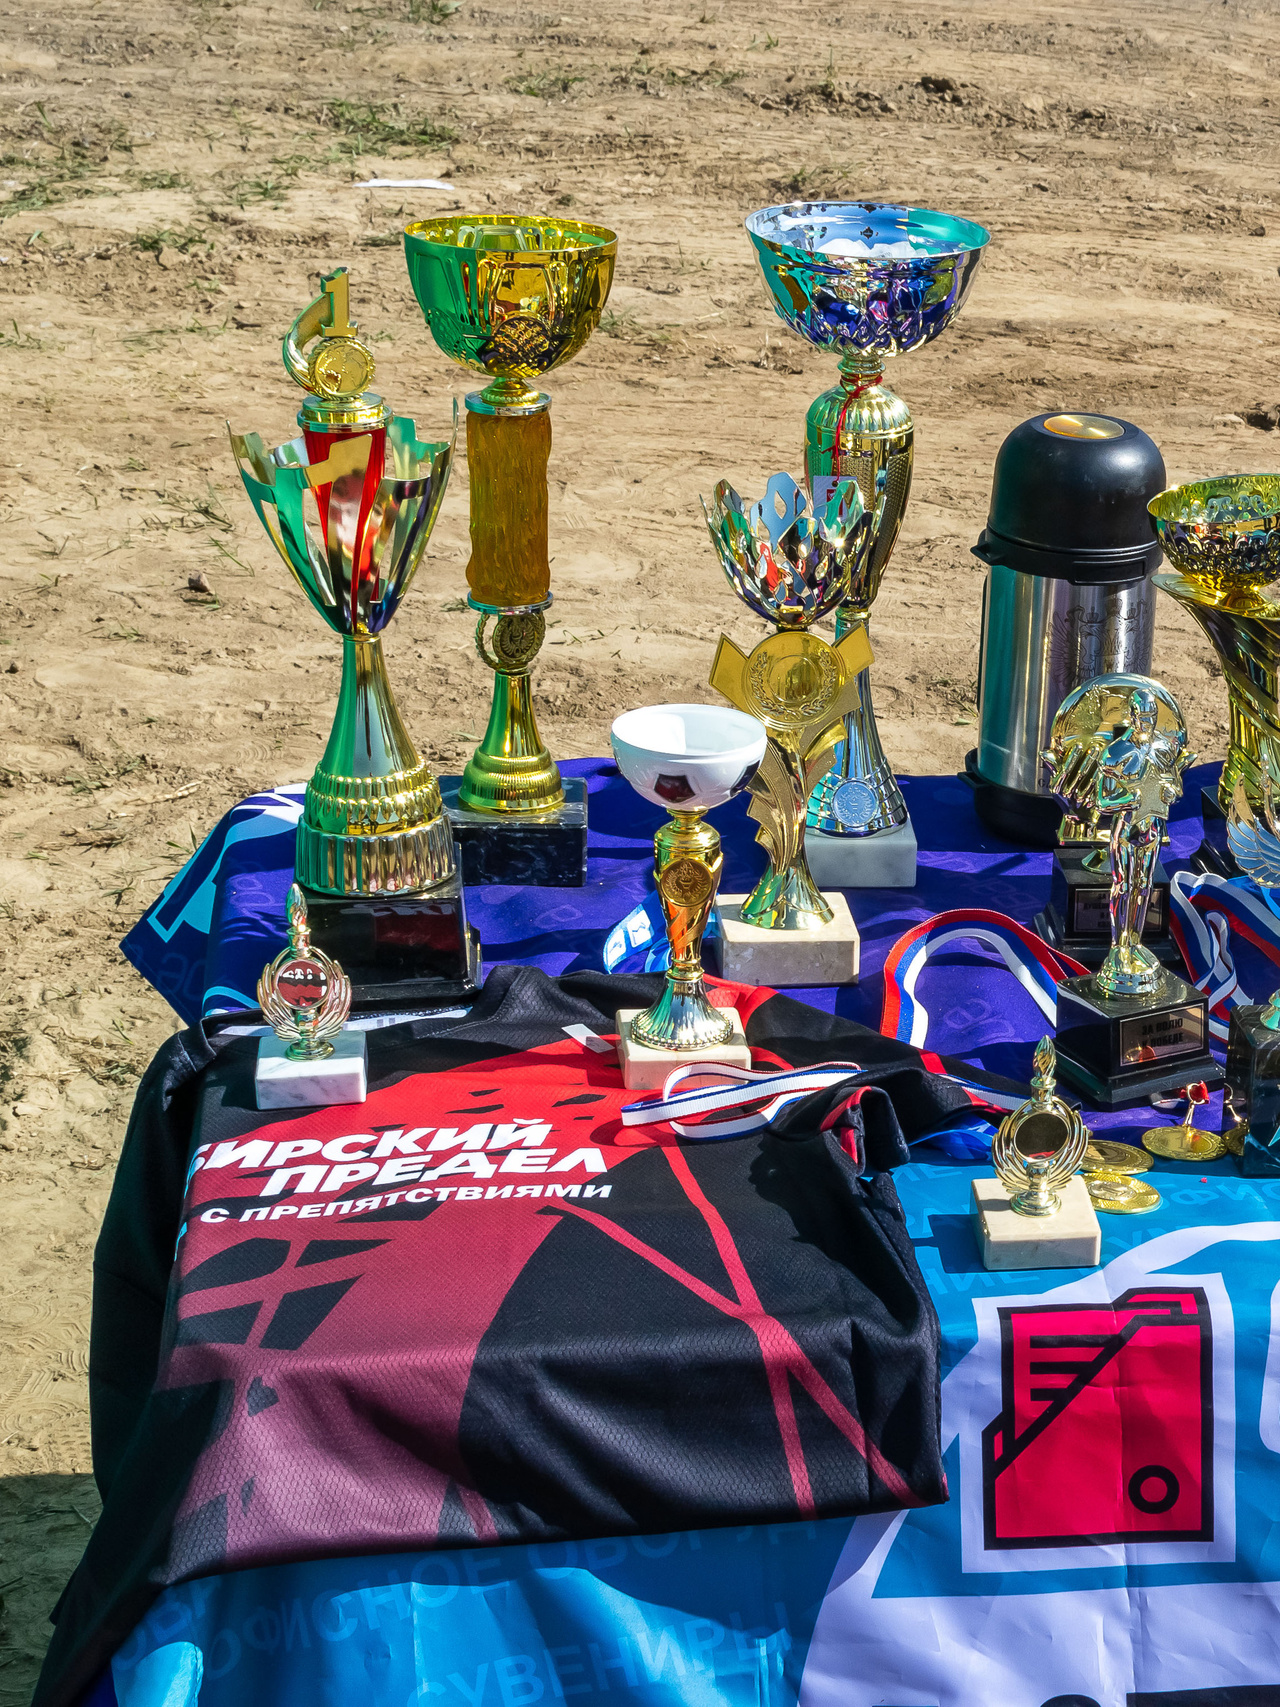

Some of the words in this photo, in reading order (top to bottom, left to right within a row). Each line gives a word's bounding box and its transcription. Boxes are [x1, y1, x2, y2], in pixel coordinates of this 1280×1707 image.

[320, 266, 358, 338] 1
[1142, 1023, 1154, 1036] ЗА
[1156, 1017, 1184, 1033] ВОЛЮ
[1150, 1032, 1184, 1048] ПОБЕДЕ
[258, 1147, 608, 1198] ПРЕДЕЛ
[200, 1208, 231, 1224] С
[238, 1183, 613, 1222] ПРЕПЯТСТВИЯМИ
